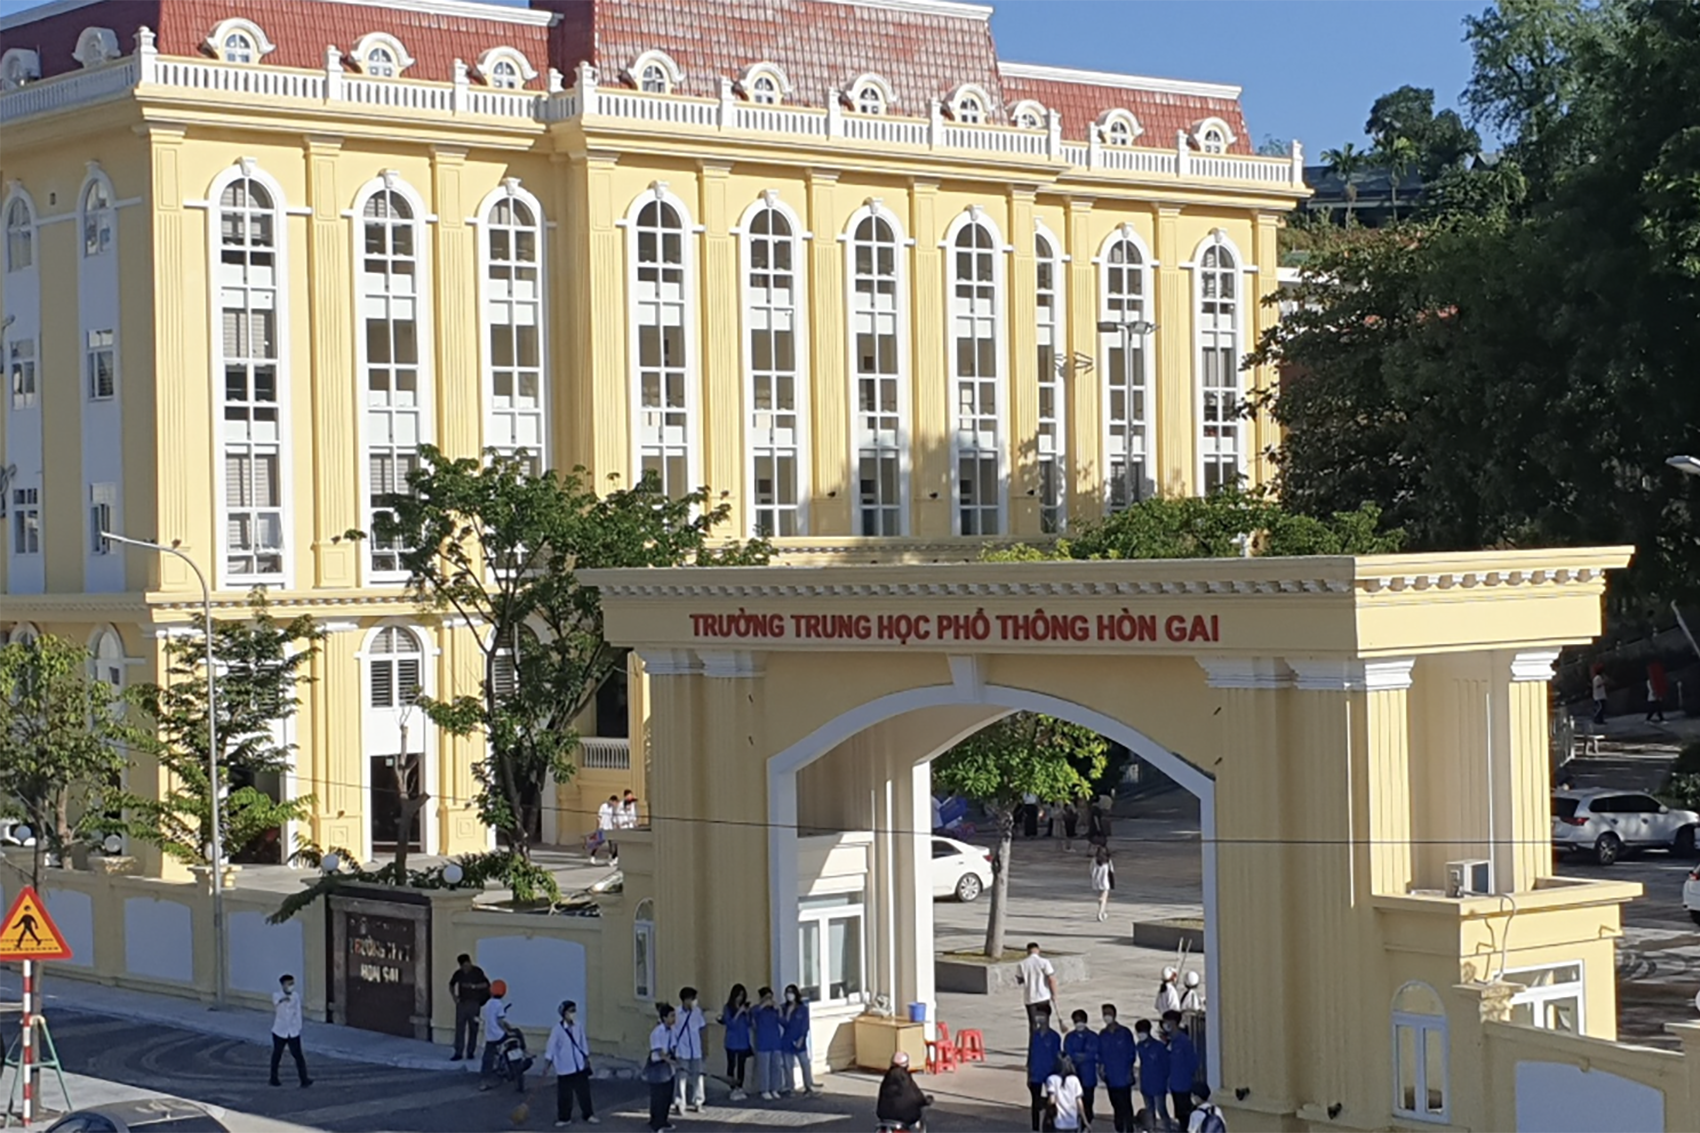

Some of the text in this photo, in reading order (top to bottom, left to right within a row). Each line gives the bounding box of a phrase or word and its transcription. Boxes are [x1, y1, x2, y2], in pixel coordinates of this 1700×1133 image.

[689, 607, 1219, 645] TRƯỜNG TRUNG HỌC PHỔ THÔNG HÒN GAI
